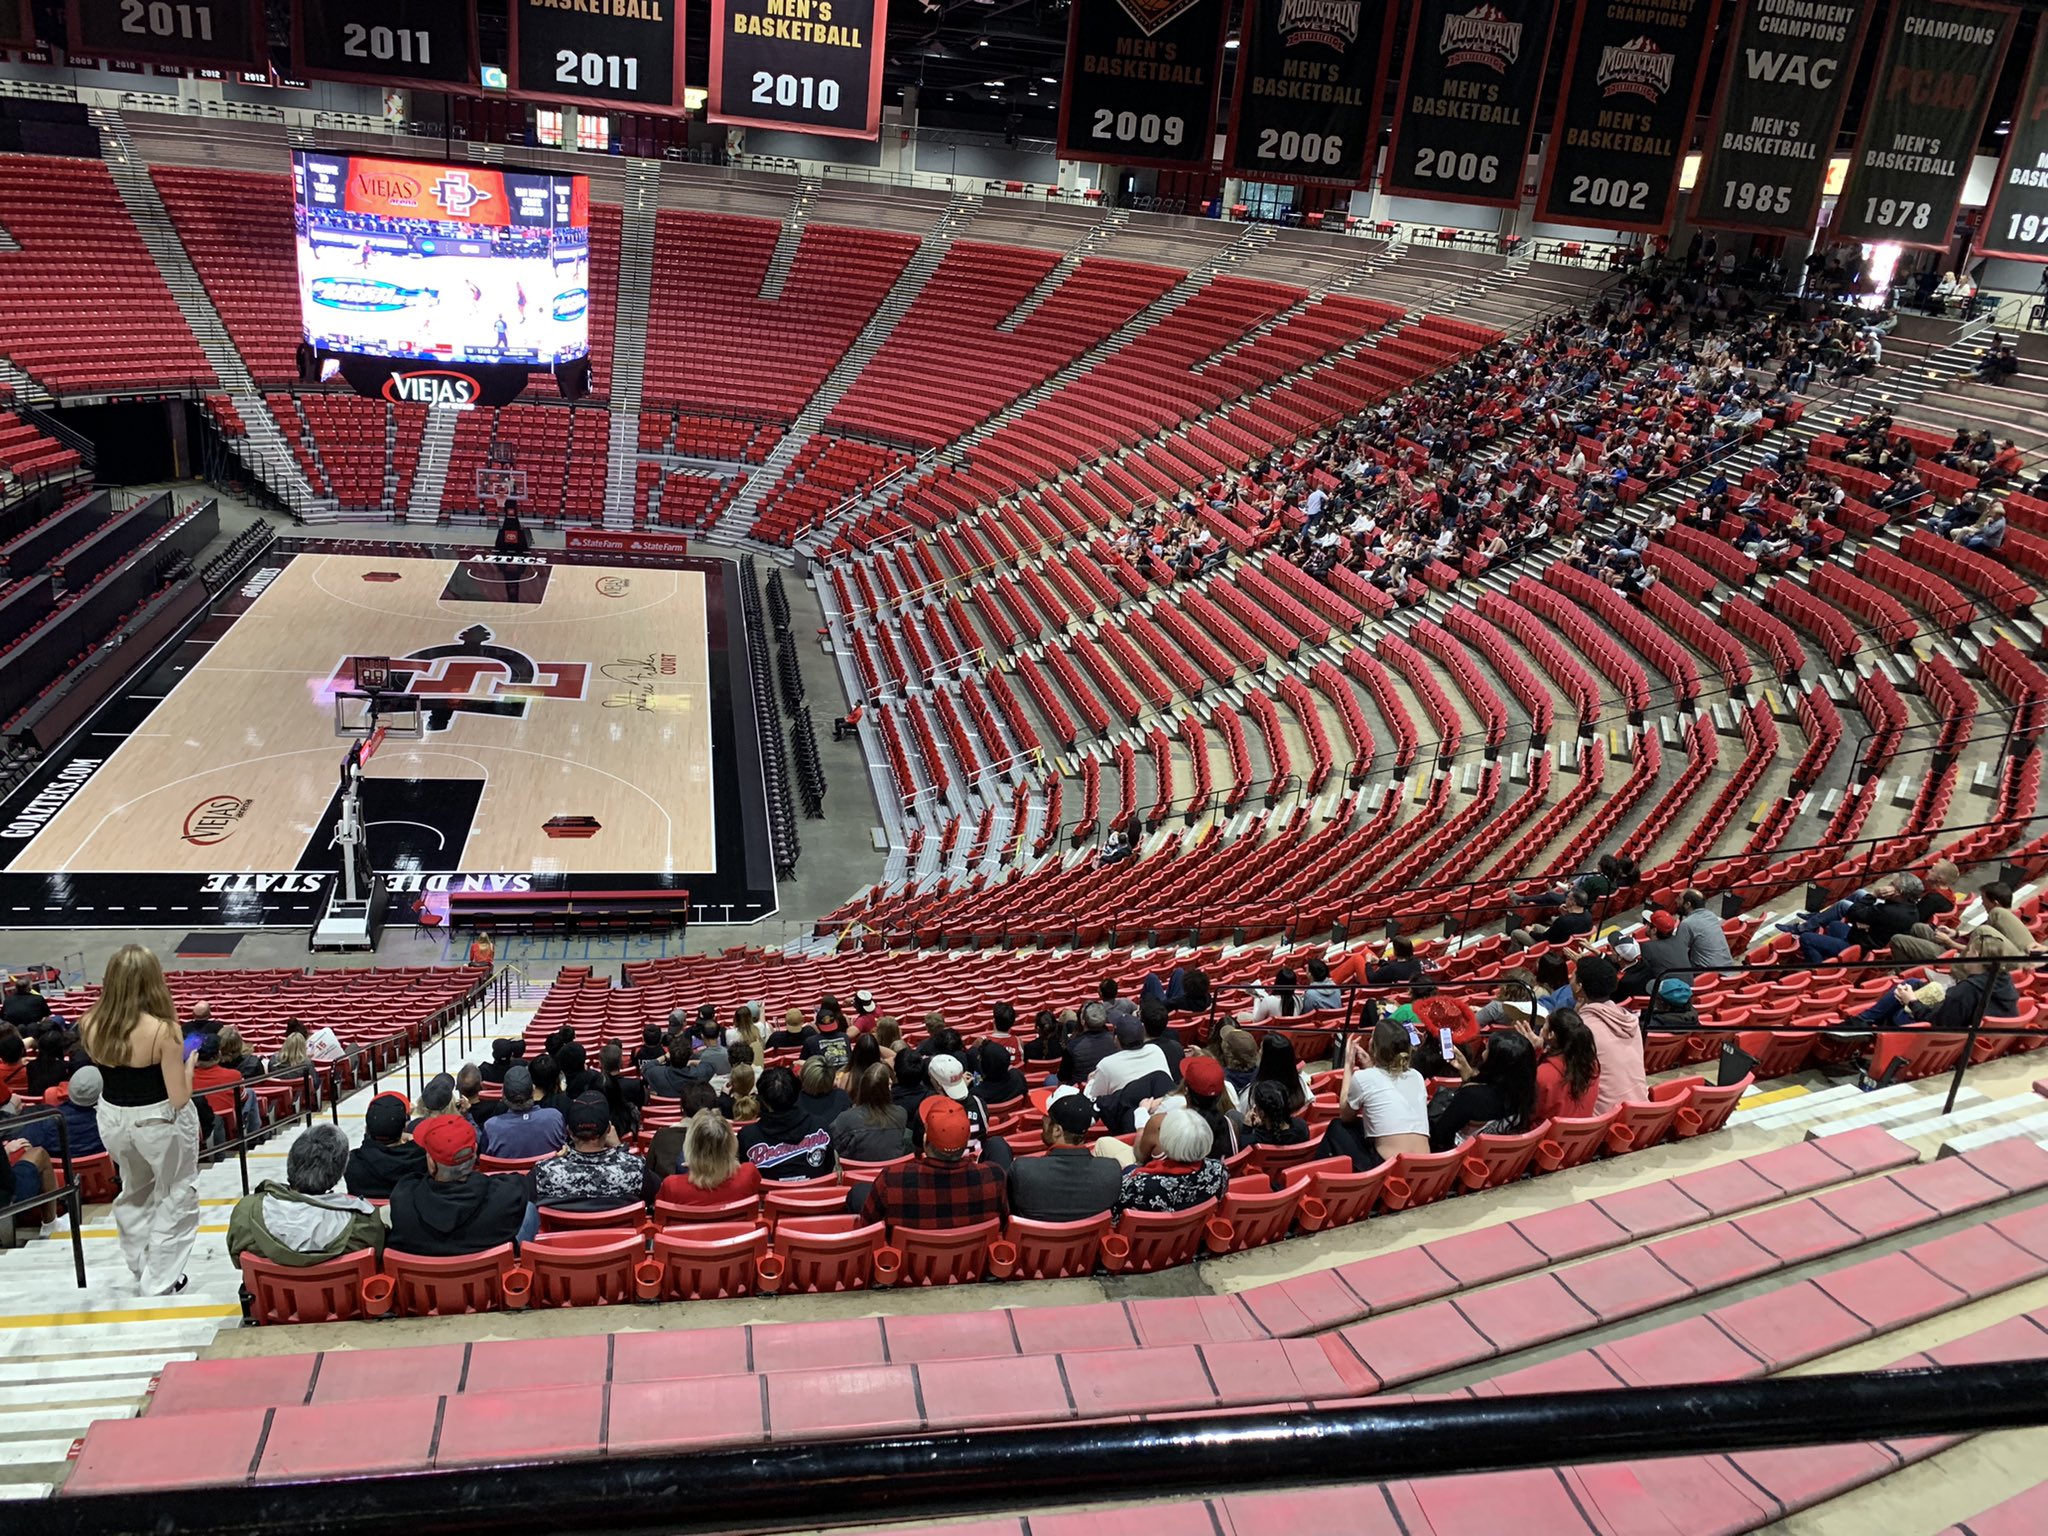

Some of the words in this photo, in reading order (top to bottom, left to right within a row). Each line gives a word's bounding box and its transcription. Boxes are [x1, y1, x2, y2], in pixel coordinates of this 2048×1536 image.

[121, 0, 213, 41] 2011
[530, 0, 663, 21] KETBALL
[766, 0, 832, 21] MEN'S
[1280, 0, 1358, 35] MOUNTAIN
[1607, 4, 1689, 29] CHAMPIONS
[1614, 0, 1696, 13] AMENT
[1757, 0, 1855, 24] TOURNAMENT
[733, 13, 863, 49] BASKETBALL
[1297, 20, 1341, 33] WEST
[1441, 15, 1520, 58] MOUNTAIN
[1758, 15, 1847, 43] CHAMPIONS
[1903, 15, 1996, 46] CHAMPIONS
[343, 23, 431, 65] 2011
[1115, 35, 1178, 61] MEN'S
[555, 49, 638, 91] 2011
[1083, 53, 1205, 86] BASKETBALL
[1282, 58, 1341, 82] MEN'S
[1599, 47, 1673, 89] MOUNTAIN
[1745, 47, 1839, 90] WAC
[751, 70, 840, 112] 2010
[1251, 75, 1363, 107] BASKETBALL
[1442, 78, 1500, 103] MEN'S
[1411, 95, 1521, 126] BASKETBALL
[1597, 109, 1653, 133] MEN'S
[1091, 108, 1185, 146] 2009
[1566, 127, 1672, 157] BASKETBALL
[1750, 116, 1800, 138] MEN'S
[1257, 128, 1343, 165] 2006
[1721, 132, 1817, 161] BASKETBALL
[1893, 133, 1941, 155] MEN'S
[1414, 147, 1500, 184] 2006
[1864, 150, 1956, 177] BASKETBALL
[358, 174, 414, 200] VIEJAS
[1569, 175, 1650, 210] 2002
[1723, 180, 1792, 214] 1985
[1864, 196, 1932, 230] 1978
[390, 371, 470, 408] VIEJAS
[468, 554, 548, 565] AZTECS
[660, 653, 677, 675] COURT
[0, 758, 103, 838] GOAZTECS.COM
[180, 801, 240, 840] VIEJAS
[199, 873, 326, 893] STATE
[381, 874, 454, 892] DIE
[458, 873, 533, 892] SAN
